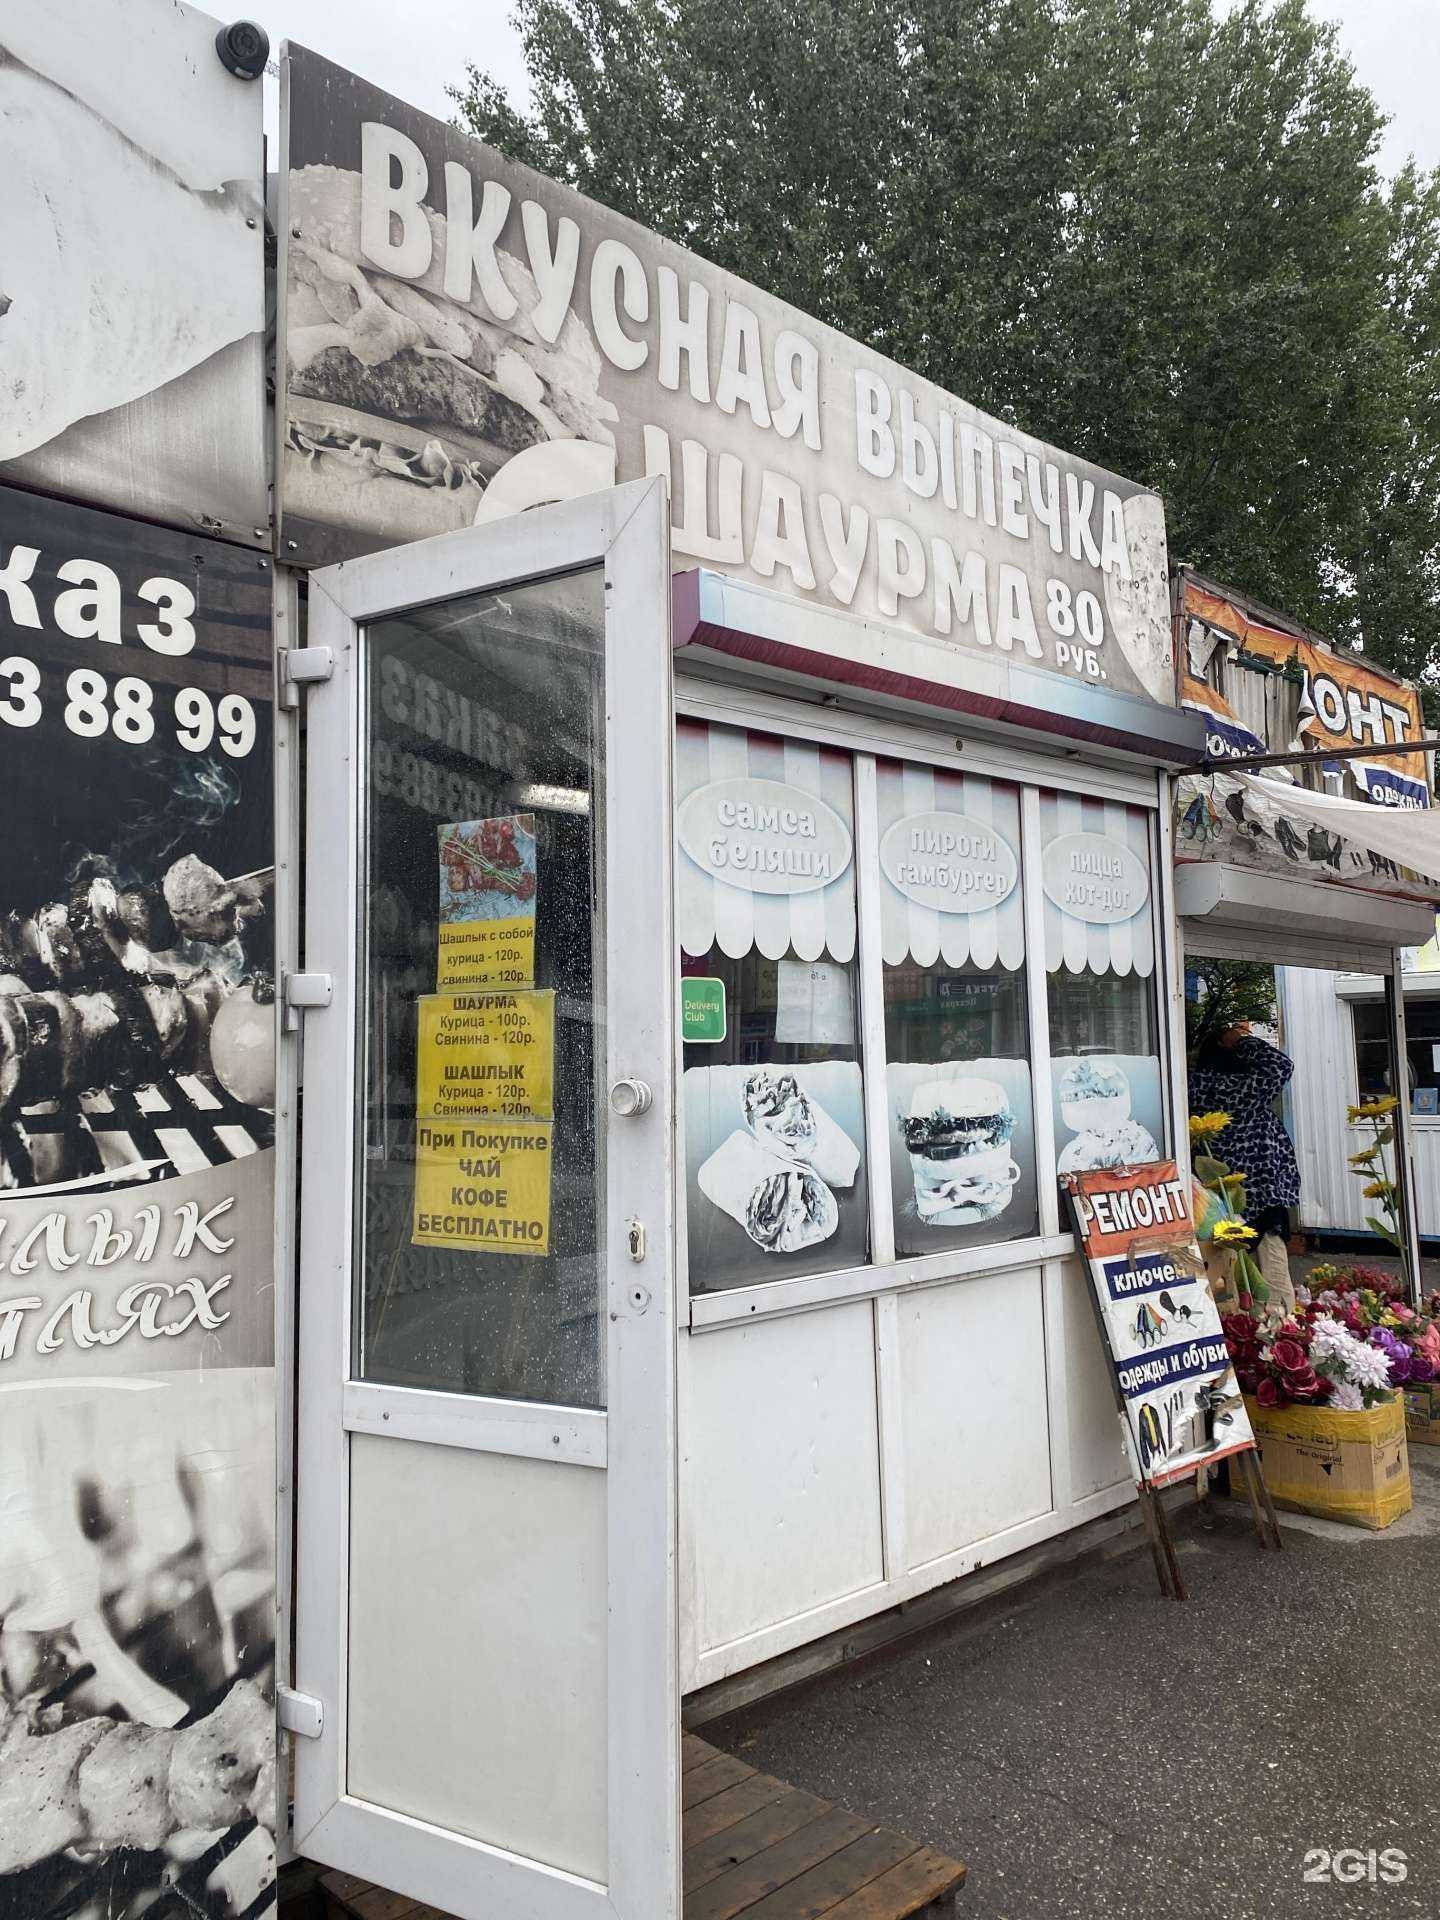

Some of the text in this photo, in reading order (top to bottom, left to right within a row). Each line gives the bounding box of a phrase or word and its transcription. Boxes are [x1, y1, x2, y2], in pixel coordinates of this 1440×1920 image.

[360, 121, 1132, 581] ВКУСНАЯ ВЫПЕЧКА
[643, 423, 1044, 659] ШАУРМА
[1046, 578, 1104, 646] 80
[64, 668, 156, 745] 88
[174, 687, 256, 758] 99
[718, 800, 817, 838] самса
[709, 832, 831, 878] беляши
[911, 828, 998, 861] пироги
[1070, 851, 1124, 881] пицца
[897, 862, 1009, 898] гамбургер
[1065, 881, 1131, 912] хот-дог
[439, 928, 534, 945] Шашлык с собой
[447, 953, 485, 968] курица
[495, 949, 524, 963] 120р.
[442, 974, 488, 985] свинина
[498, 970, 527, 984] 120р.
[453, 996, 518, 1010] ШАУРМА
[685, 1000, 720, 1013] Delivery
[440, 1015, 485, 1031] Курица
[497, 1014, 531, 1030] 100р.
[684, 1011, 705, 1022] Club
[435, 1033, 490, 1046] Свинина
[501, 1031, 536, 1047] 120р.
[444, 1065, 525, 1080] ШАШЛЫК
[439, 1085, 484, 1101] Курица
[496, 1085, 530, 1101] 120р.
[433, 1102, 489, 1116] Свинина
[500, 1102, 535, 1116] 120р.
[419, 1128, 548, 1154] При Покупке
[459, 1156, 502, 1178] ЧАЙ
[451, 1186, 508, 1208] КОФЕ
[1072, 1181, 1187, 1237] РЕМОНТ
[418, 1213, 544, 1241] БЕСПЛАТНО
[1118, 1343, 1230, 1392] одежды и обуви
